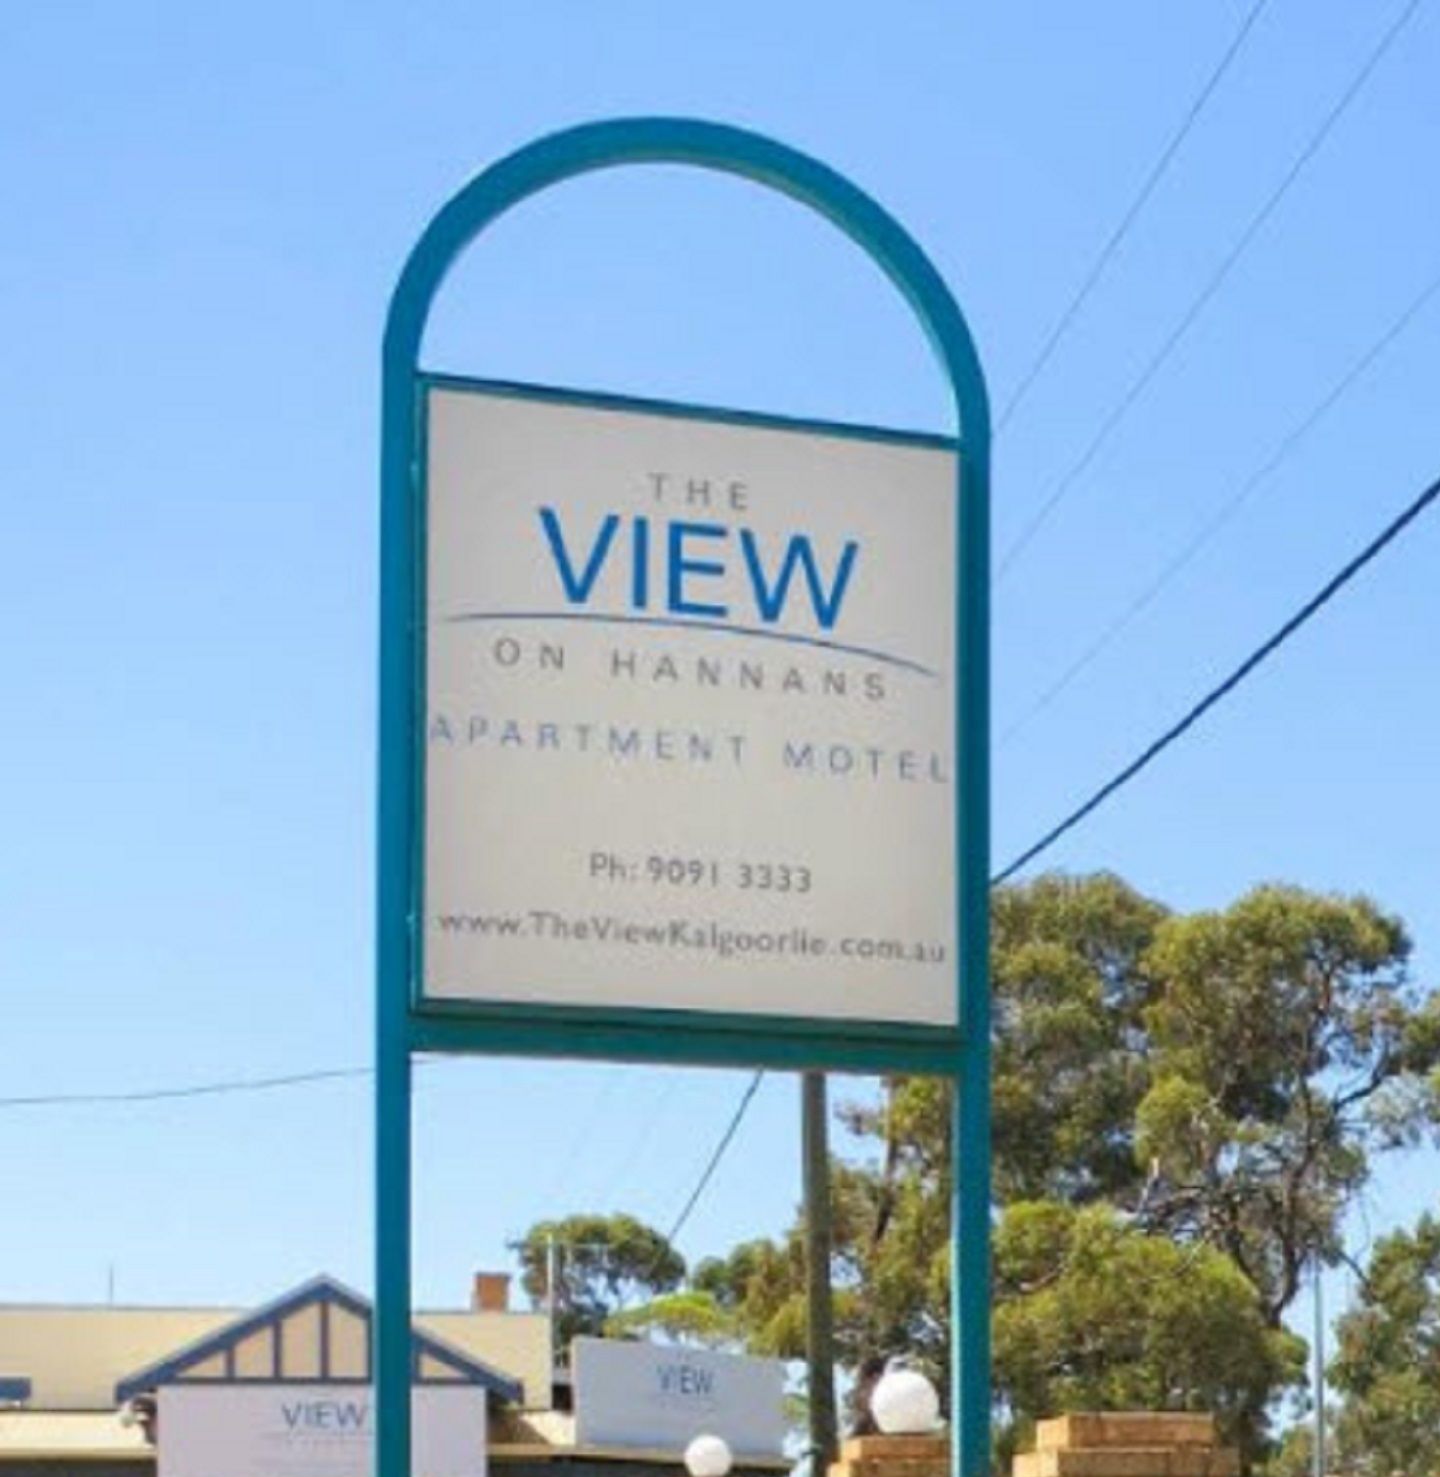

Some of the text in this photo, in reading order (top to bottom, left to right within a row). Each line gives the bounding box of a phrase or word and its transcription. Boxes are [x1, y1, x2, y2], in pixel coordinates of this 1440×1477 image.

[648, 472, 750, 511] THE
[538, 506, 860, 631] VIEW
[493, 637, 888, 701] ON HANNANS
[430, 714, 948, 784] APARTMENT MOTEL
[589, 852, 813, 893] Ph: 9091 3333
[437, 910, 947, 965] www.TheViewKalgoorlie.com.au
[657, 1364, 714, 1395] VIEW
[281, 1402, 367, 1429] VIEW
